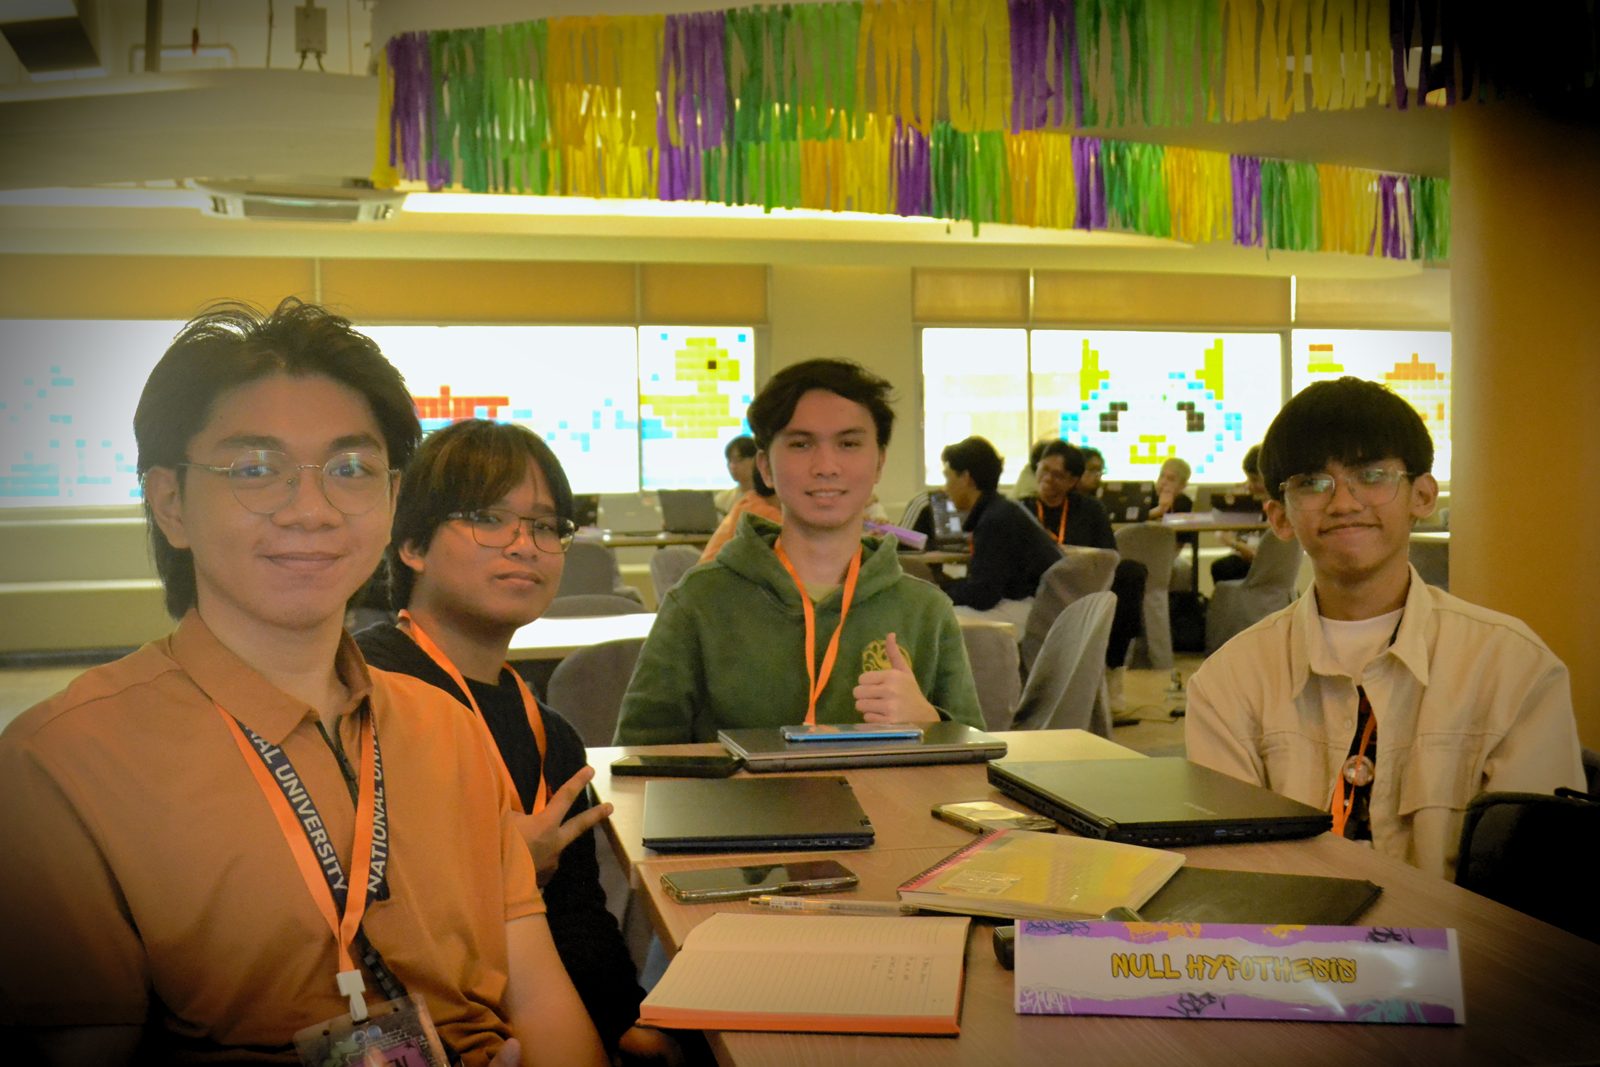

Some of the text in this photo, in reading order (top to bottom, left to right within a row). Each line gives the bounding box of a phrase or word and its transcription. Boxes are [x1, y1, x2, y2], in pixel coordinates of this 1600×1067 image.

[275, 763, 348, 890] UNIVERSITY
[368, 786, 387, 893] NATIONAL
[1111, 952, 1181, 980] NULL
